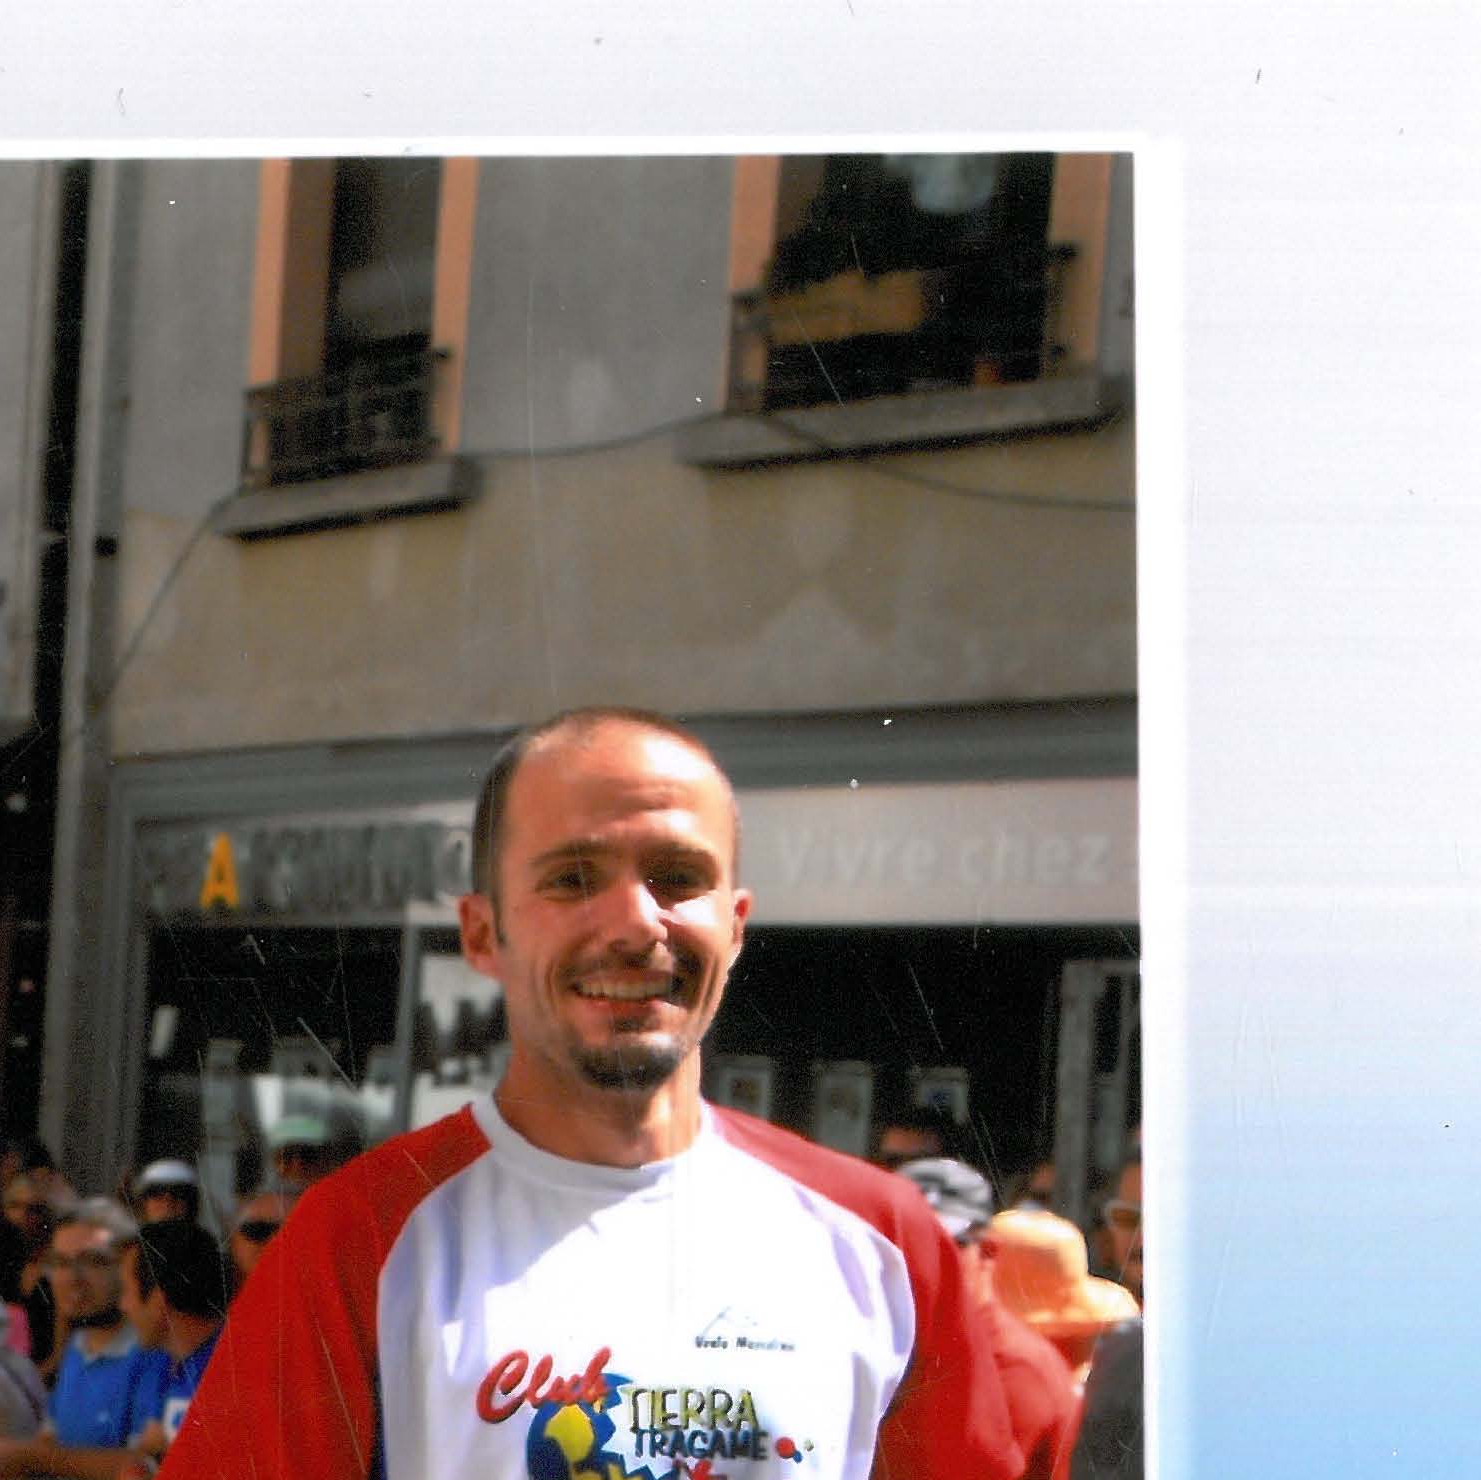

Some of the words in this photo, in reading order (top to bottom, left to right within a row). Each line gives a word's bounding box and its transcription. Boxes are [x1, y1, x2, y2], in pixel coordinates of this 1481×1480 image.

[959, 826, 1116, 887] chez
[476, 1345, 611, 1424] Club
[622, 1386, 761, 1432] TIERRA
